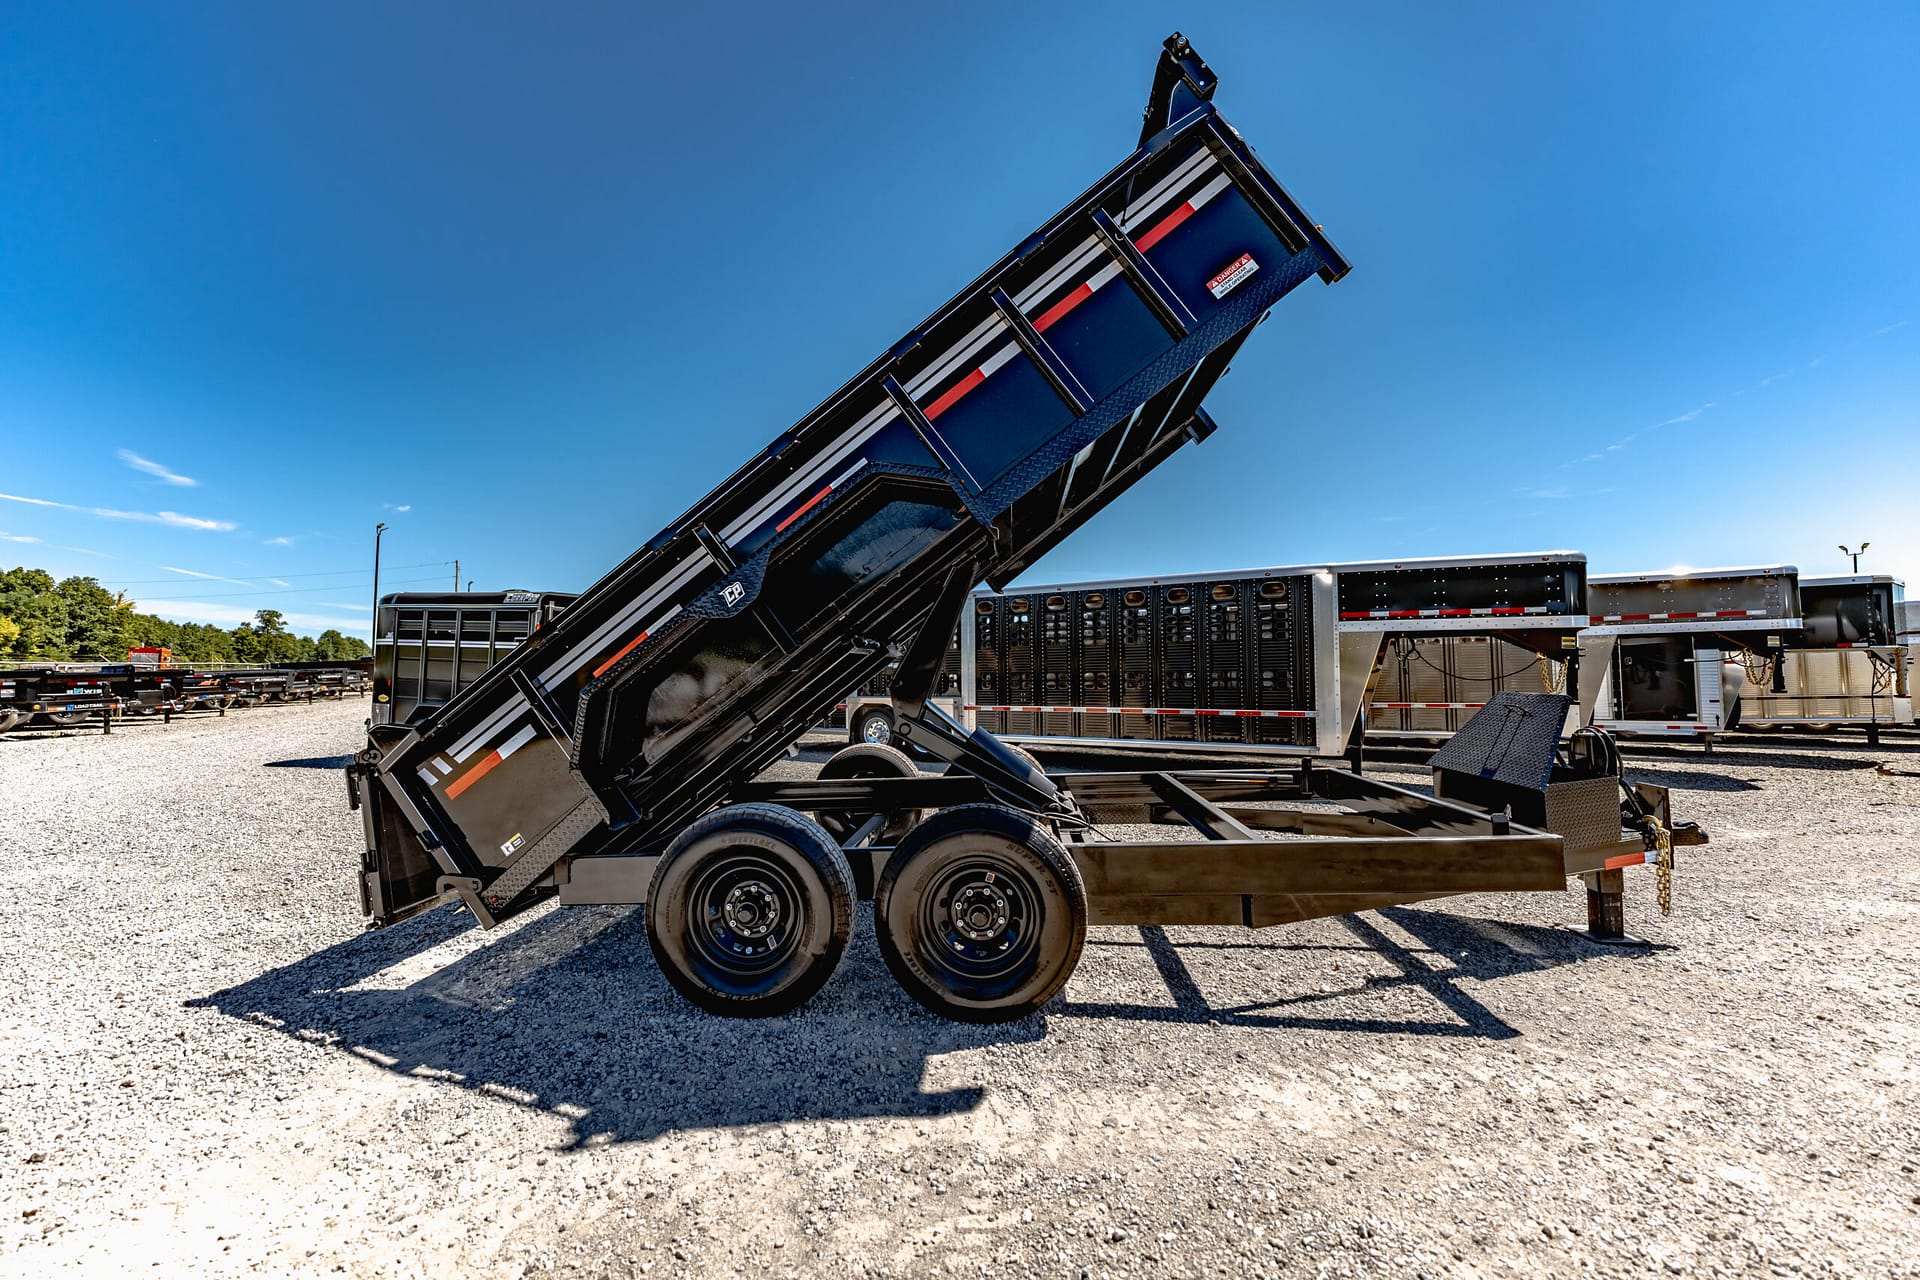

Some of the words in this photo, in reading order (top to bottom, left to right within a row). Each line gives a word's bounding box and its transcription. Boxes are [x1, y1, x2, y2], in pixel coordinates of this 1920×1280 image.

[1216, 262, 1242, 282] DANGER
[1220, 276, 1234, 288] STAND
[1233, 266, 1247, 279] CLEAR
[1005, 842, 1047, 875] SUPER
[1045, 879, 1059, 897] ST
